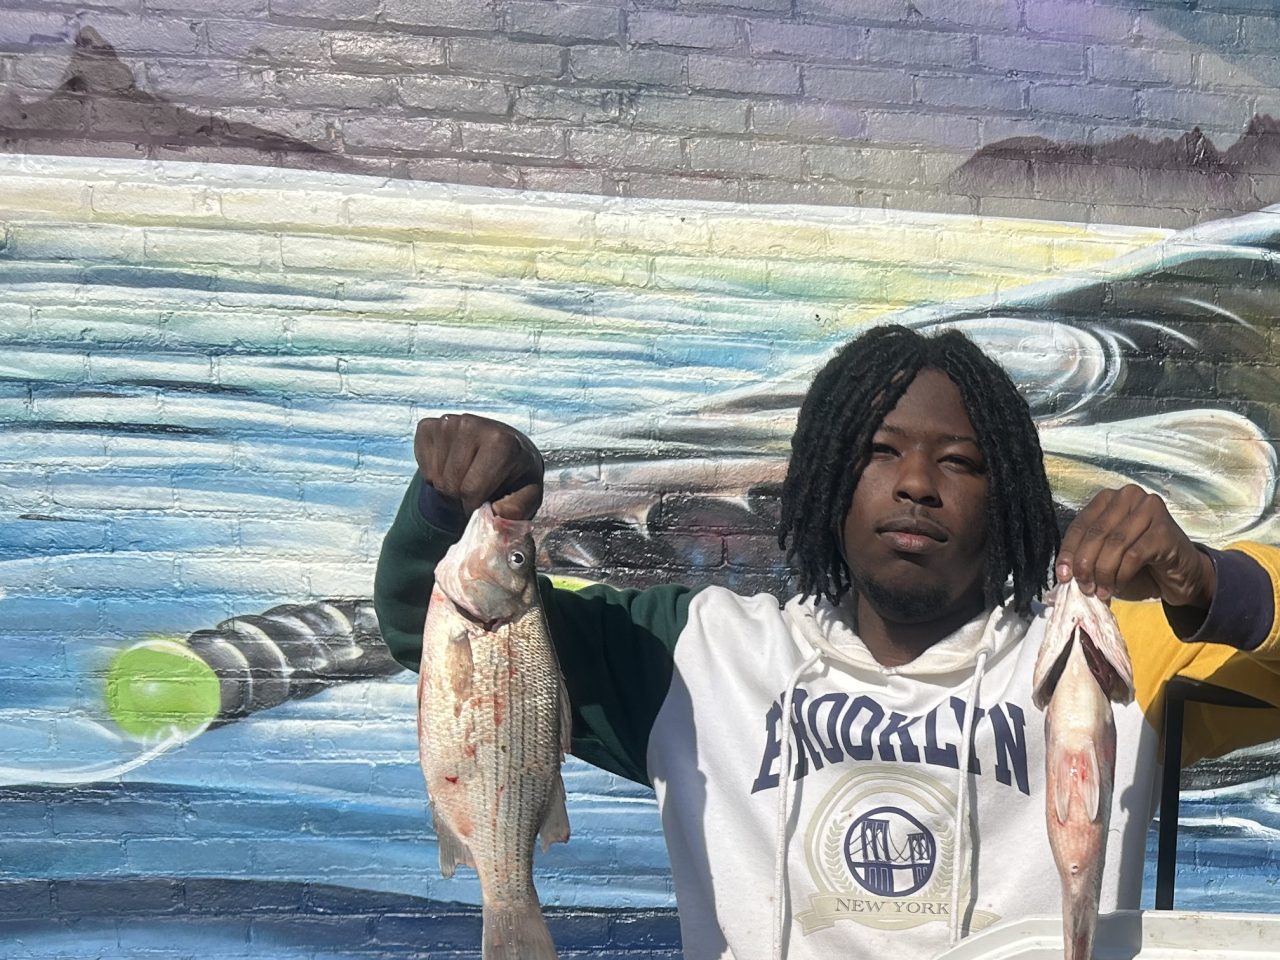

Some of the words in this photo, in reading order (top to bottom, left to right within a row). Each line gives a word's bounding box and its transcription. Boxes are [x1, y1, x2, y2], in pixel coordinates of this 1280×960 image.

[751, 688, 1030, 796] BROOKLYN
[835, 898, 886, 914] NEW
[891, 900, 950, 915] YORK
